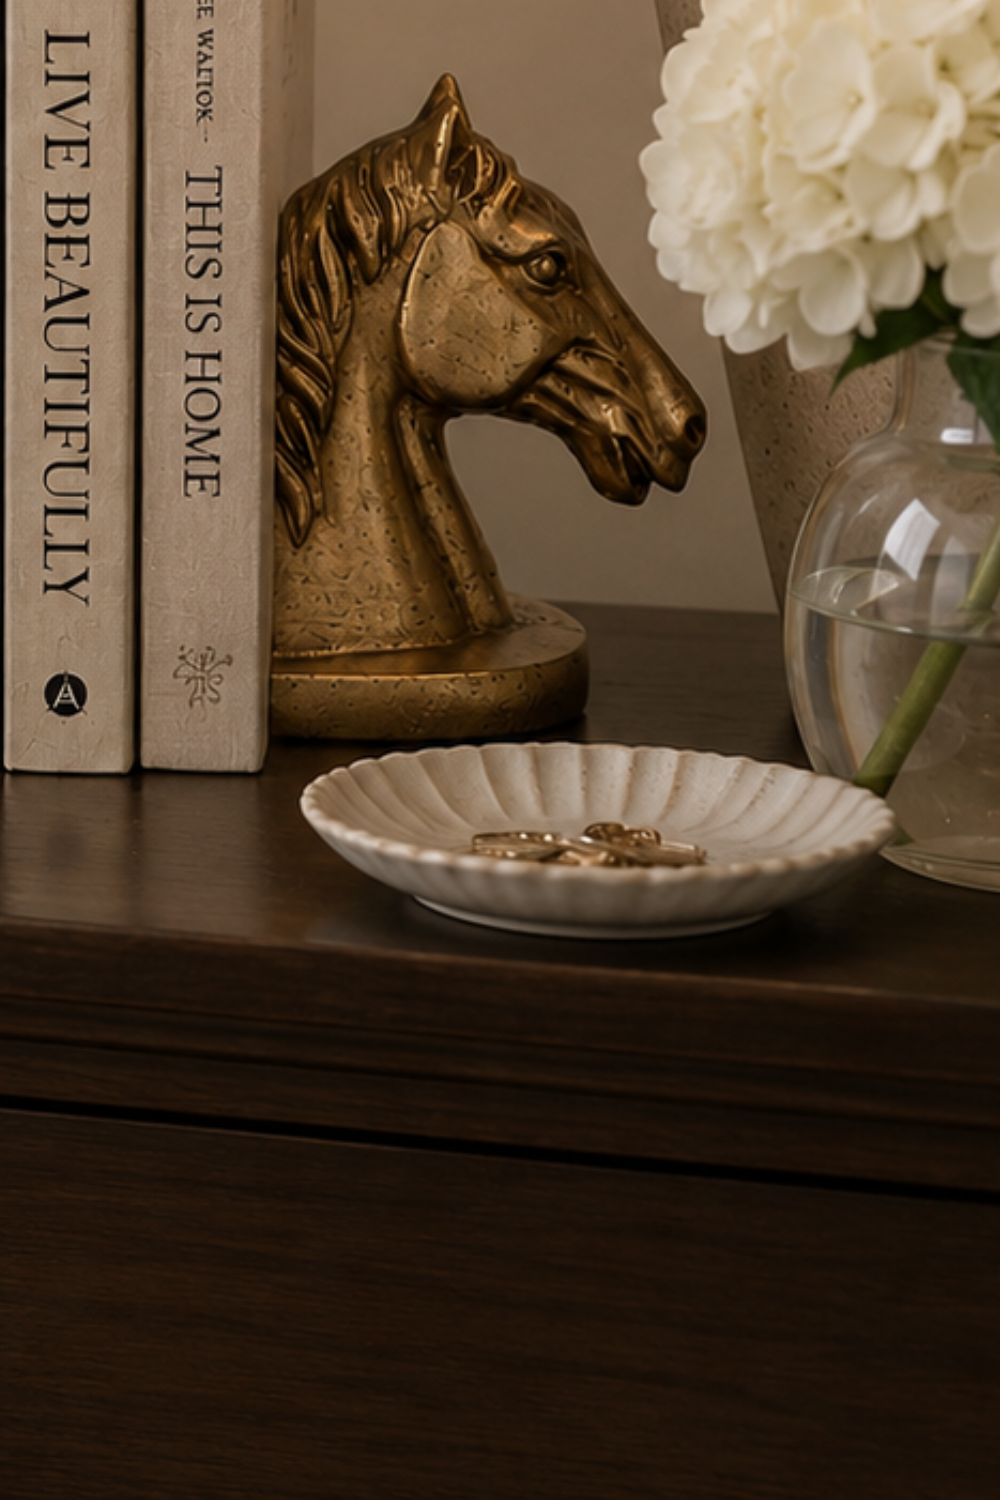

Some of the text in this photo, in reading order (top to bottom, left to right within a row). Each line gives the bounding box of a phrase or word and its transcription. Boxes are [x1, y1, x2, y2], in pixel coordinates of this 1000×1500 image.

[185, 166, 222, 279] THIS
[43, 30, 90, 605] LIVE BEAUTIFULLY
[185, 294, 221, 333] IS
[184, 351, 221, 497] HOME
